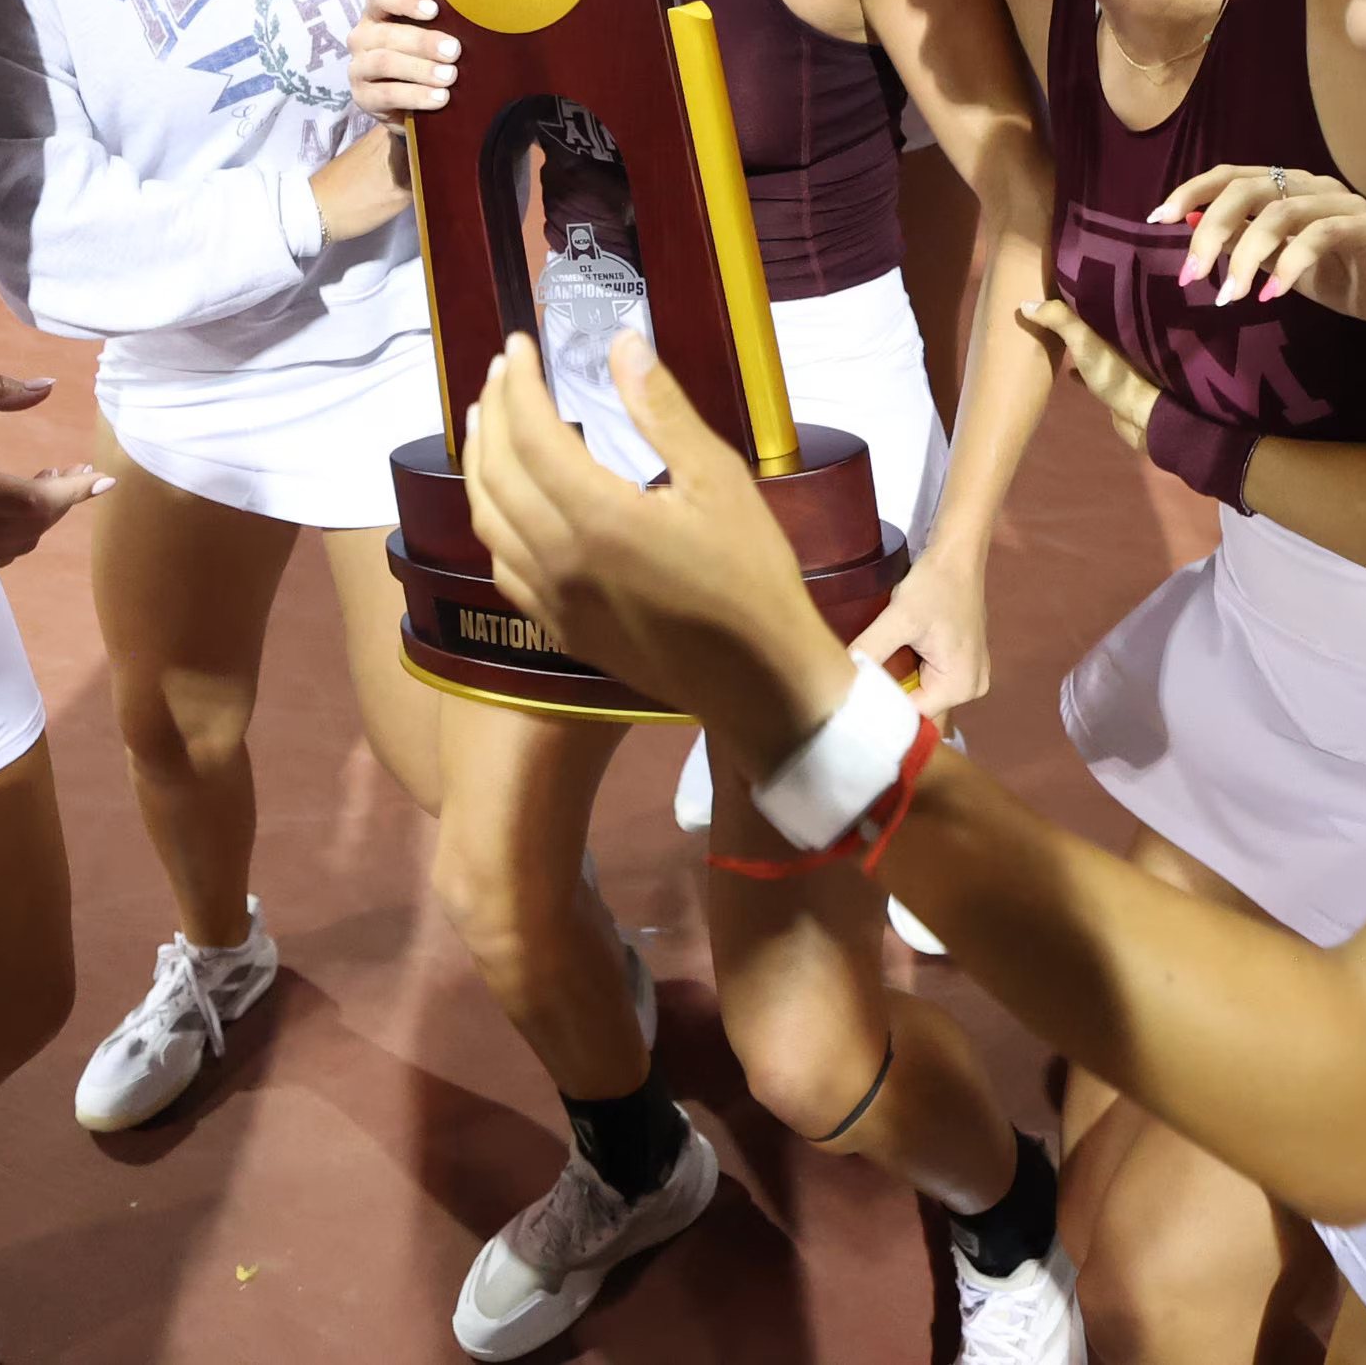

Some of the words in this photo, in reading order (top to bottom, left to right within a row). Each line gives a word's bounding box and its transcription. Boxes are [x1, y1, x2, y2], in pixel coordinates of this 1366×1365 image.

[579, 264, 593, 273] DI
[592, 271, 625, 281] TENNIS
[538, 281, 644, 300] CHAMPIONSHIPS
[459, 608, 569, 655] NATIONA
